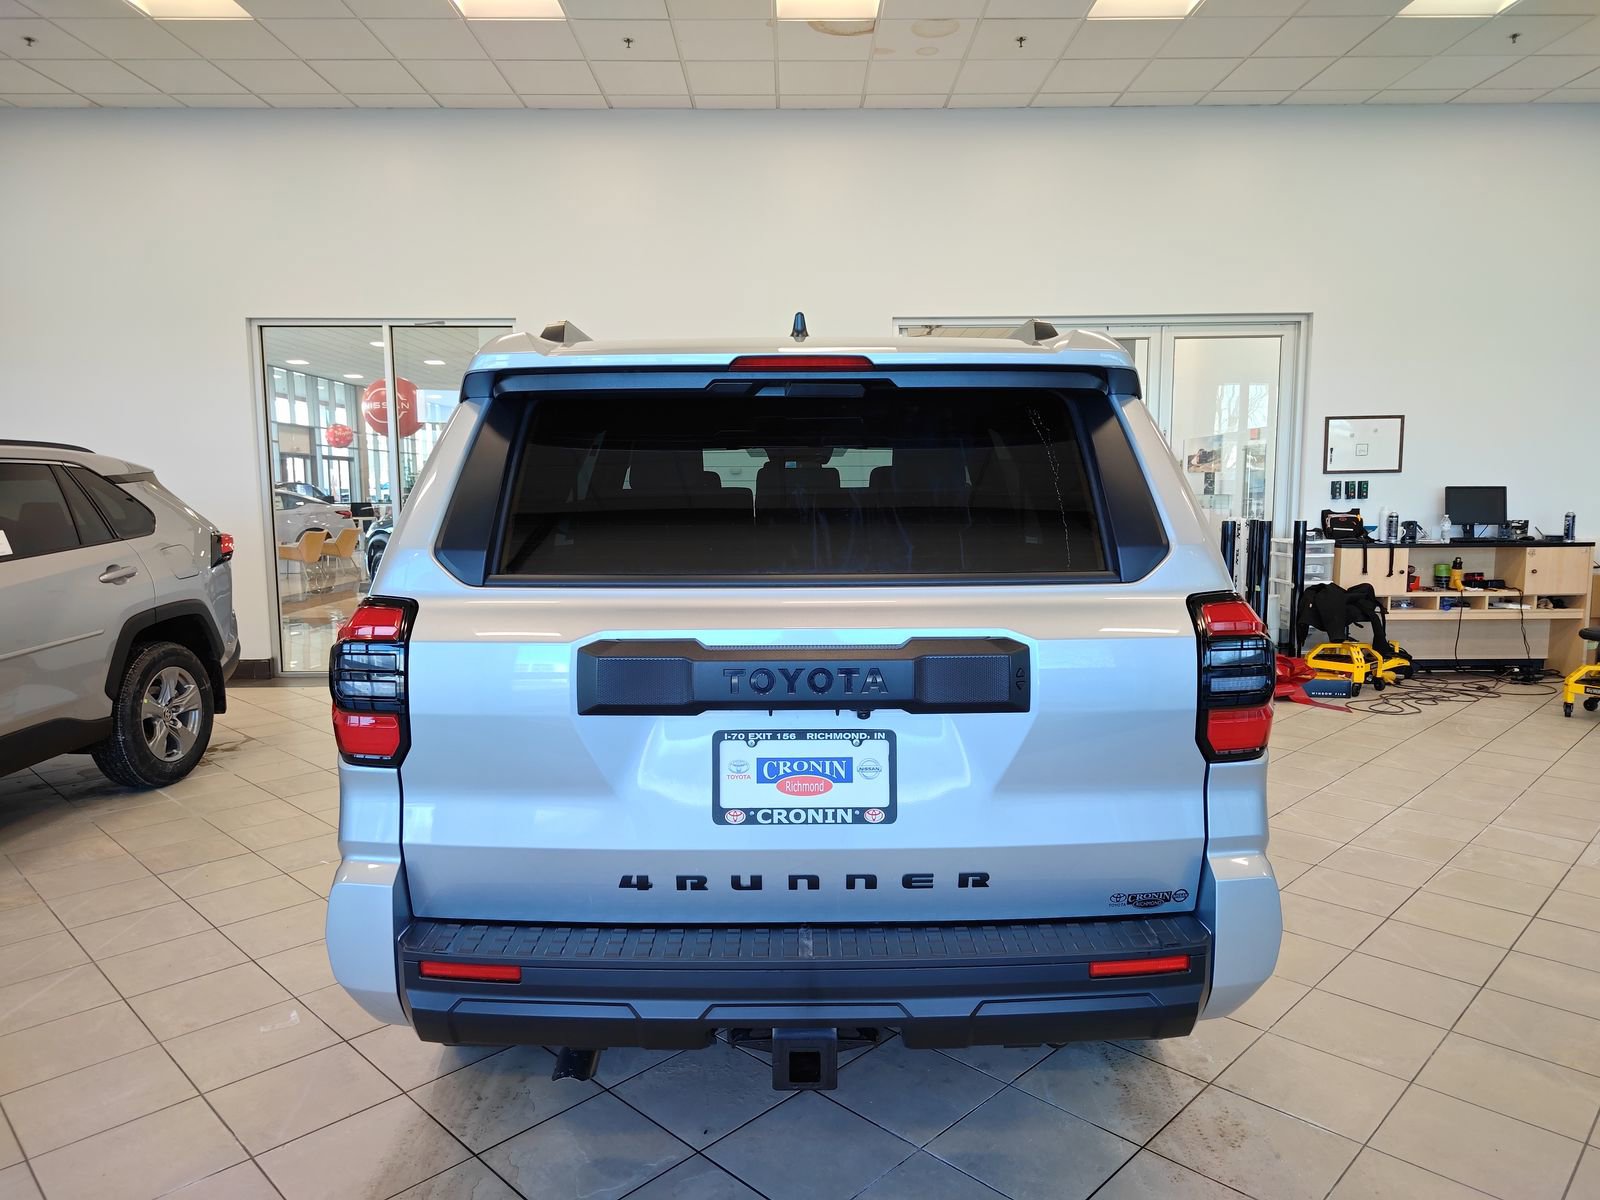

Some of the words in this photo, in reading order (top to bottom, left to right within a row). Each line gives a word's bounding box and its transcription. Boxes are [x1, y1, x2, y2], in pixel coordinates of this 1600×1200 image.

[723, 667, 889, 696] TOYOTA
[724, 732, 745, 740] I-70
[749, 732, 772, 740] EXIT
[777, 732, 796, 740] 156
[874, 732, 886, 740] IN
[763, 760, 847, 780] CRONIN
[785, 781, 825, 792] Richmond
[756, 808, 853, 824] CRONIN
[1128, 891, 1172, 903] CRONIN
